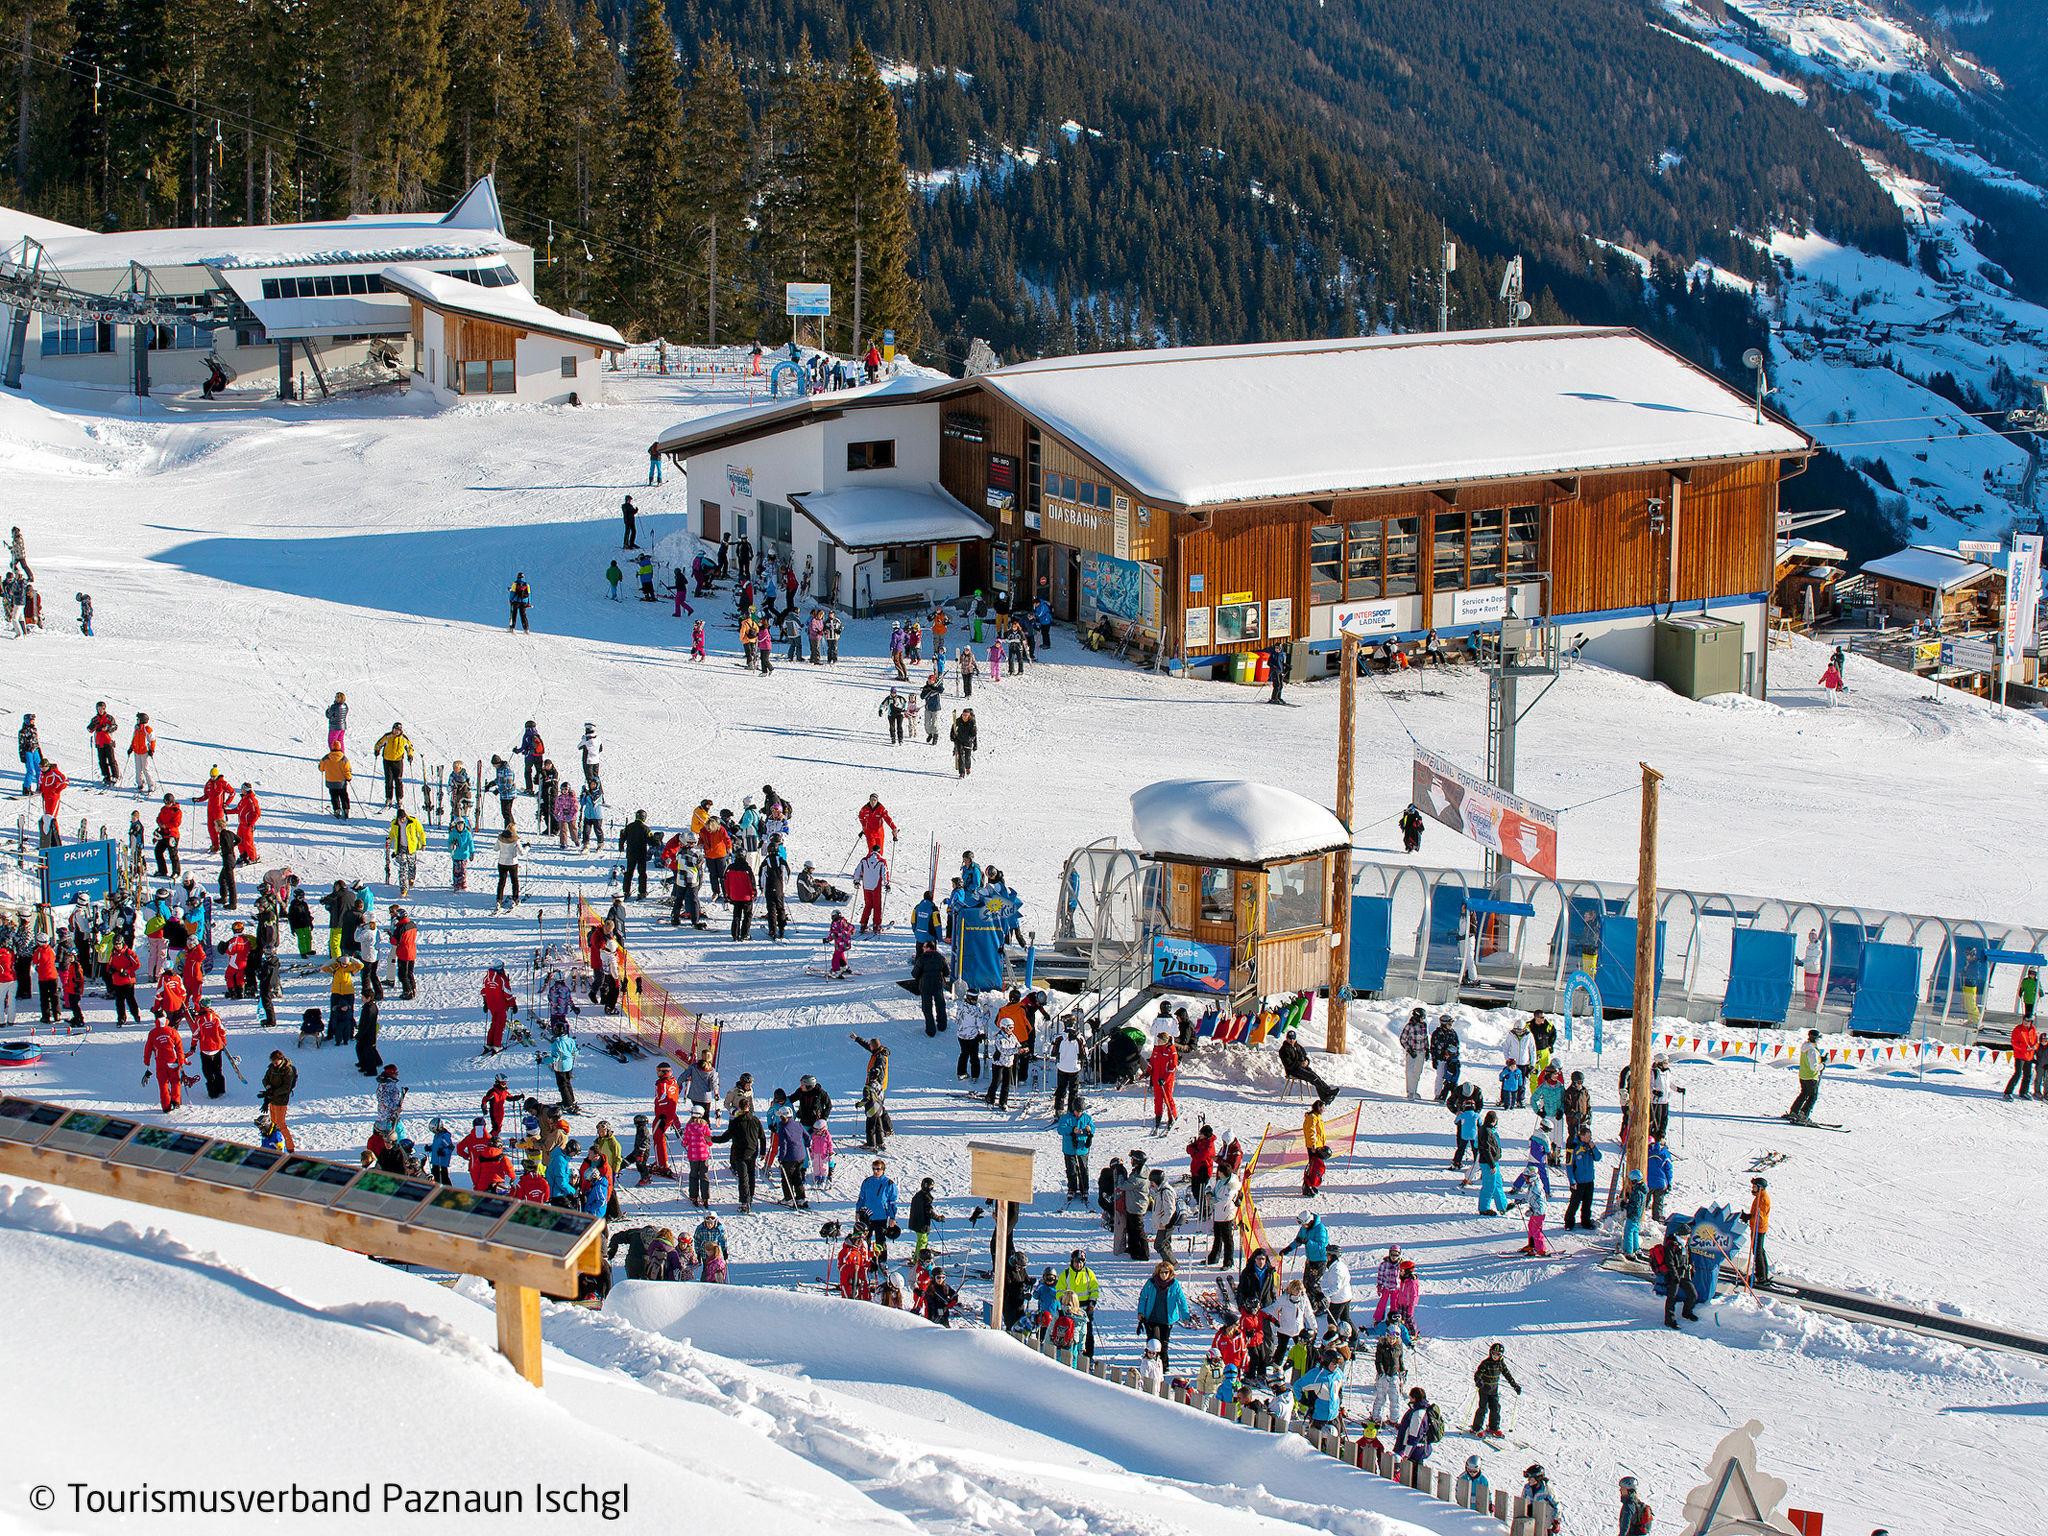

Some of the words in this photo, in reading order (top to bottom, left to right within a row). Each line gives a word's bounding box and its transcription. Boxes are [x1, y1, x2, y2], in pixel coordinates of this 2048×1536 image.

[1048, 503, 1097, 530] DIASBAHN
[1461, 597, 1485, 606] Service
[2008, 559, 2024, 643] INTERSPORT
[1354, 609, 1391, 620] INTERSPORT
[1461, 607, 1478, 616] Shop
[1483, 605, 1499, 613] Rent
[1359, 617, 1386, 626] LADNER
[1457, 773, 1524, 813] FORTGESCHRITTENE
[1529, 804, 1556, 827] KINDER
[64, 848, 100, 862] PRIVAT
[1163, 945, 1199, 958] Ausgabe
[1691, 1235, 1729, 1248] SunKid
